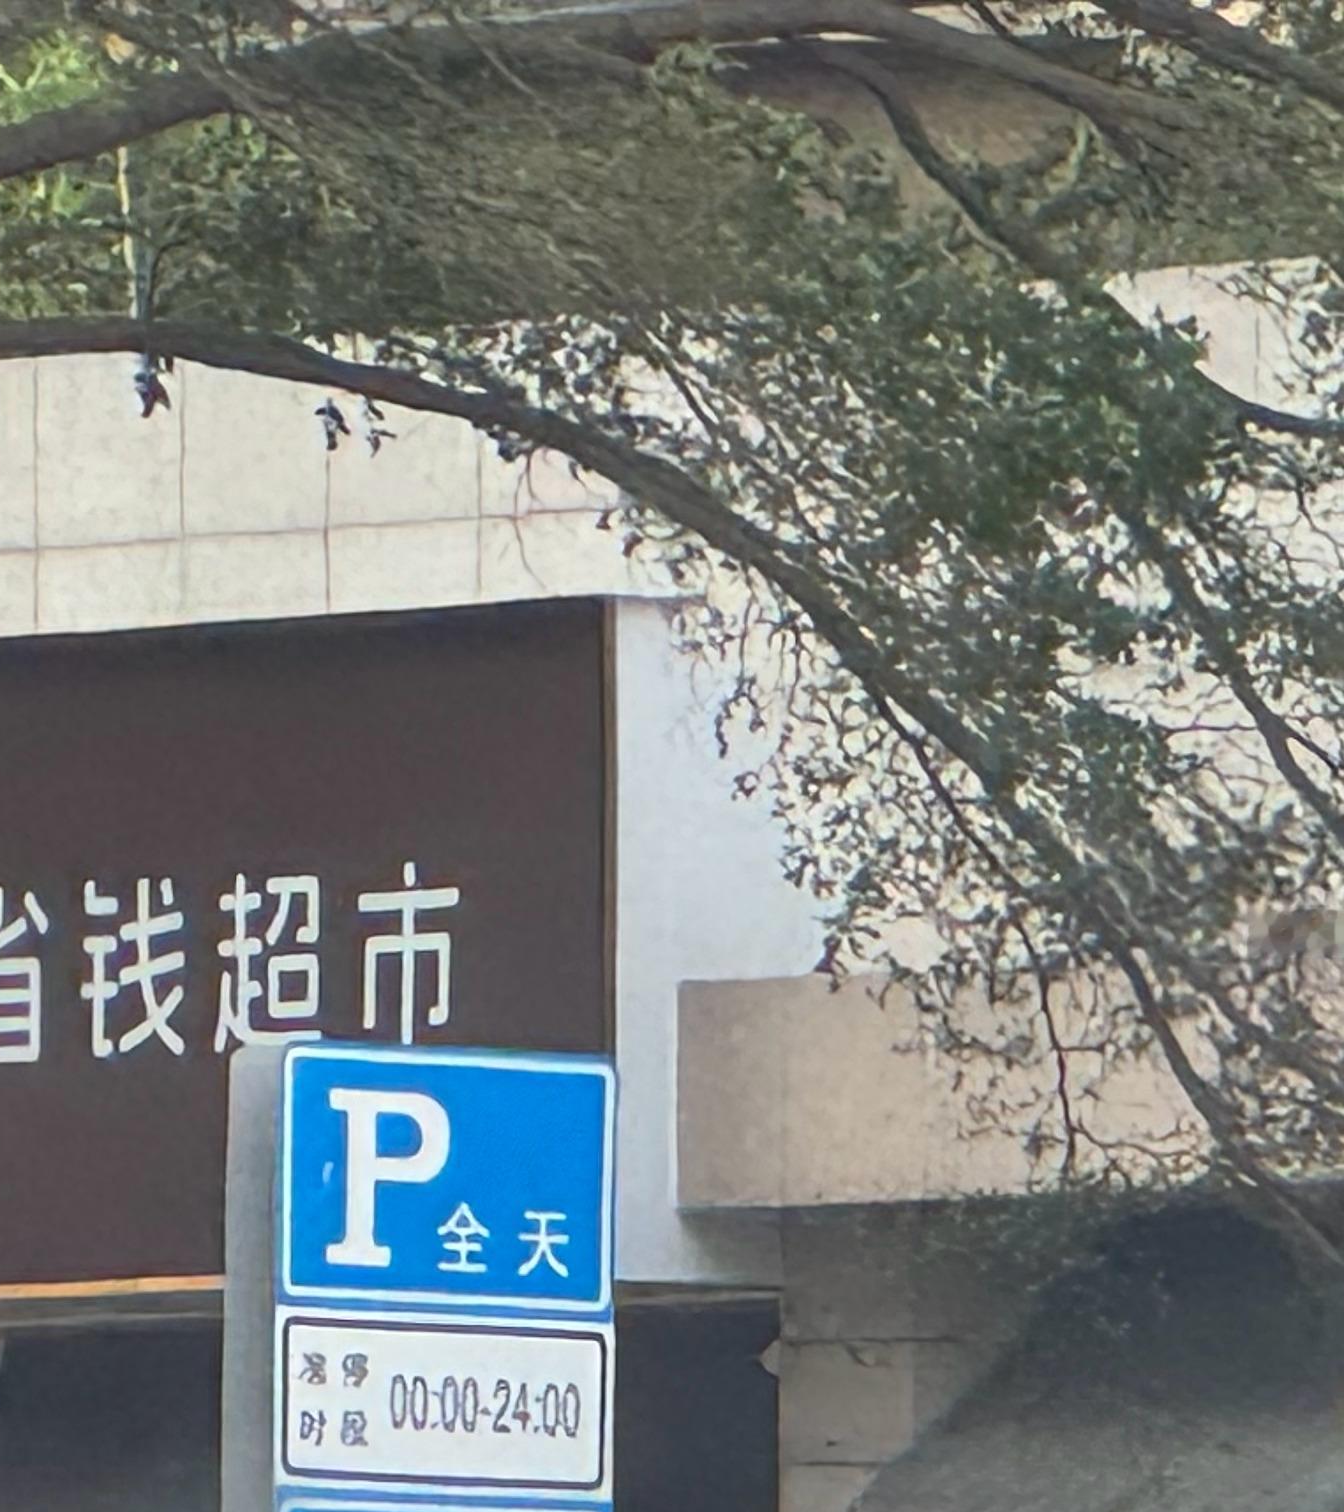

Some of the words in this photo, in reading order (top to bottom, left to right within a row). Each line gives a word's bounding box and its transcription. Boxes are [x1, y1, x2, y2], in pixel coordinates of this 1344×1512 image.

[325, 1088, 451, 1267] P
[437, 1202, 570, 1278] 全天
[389, 1373, 581, 1438] 00:00-24:00
